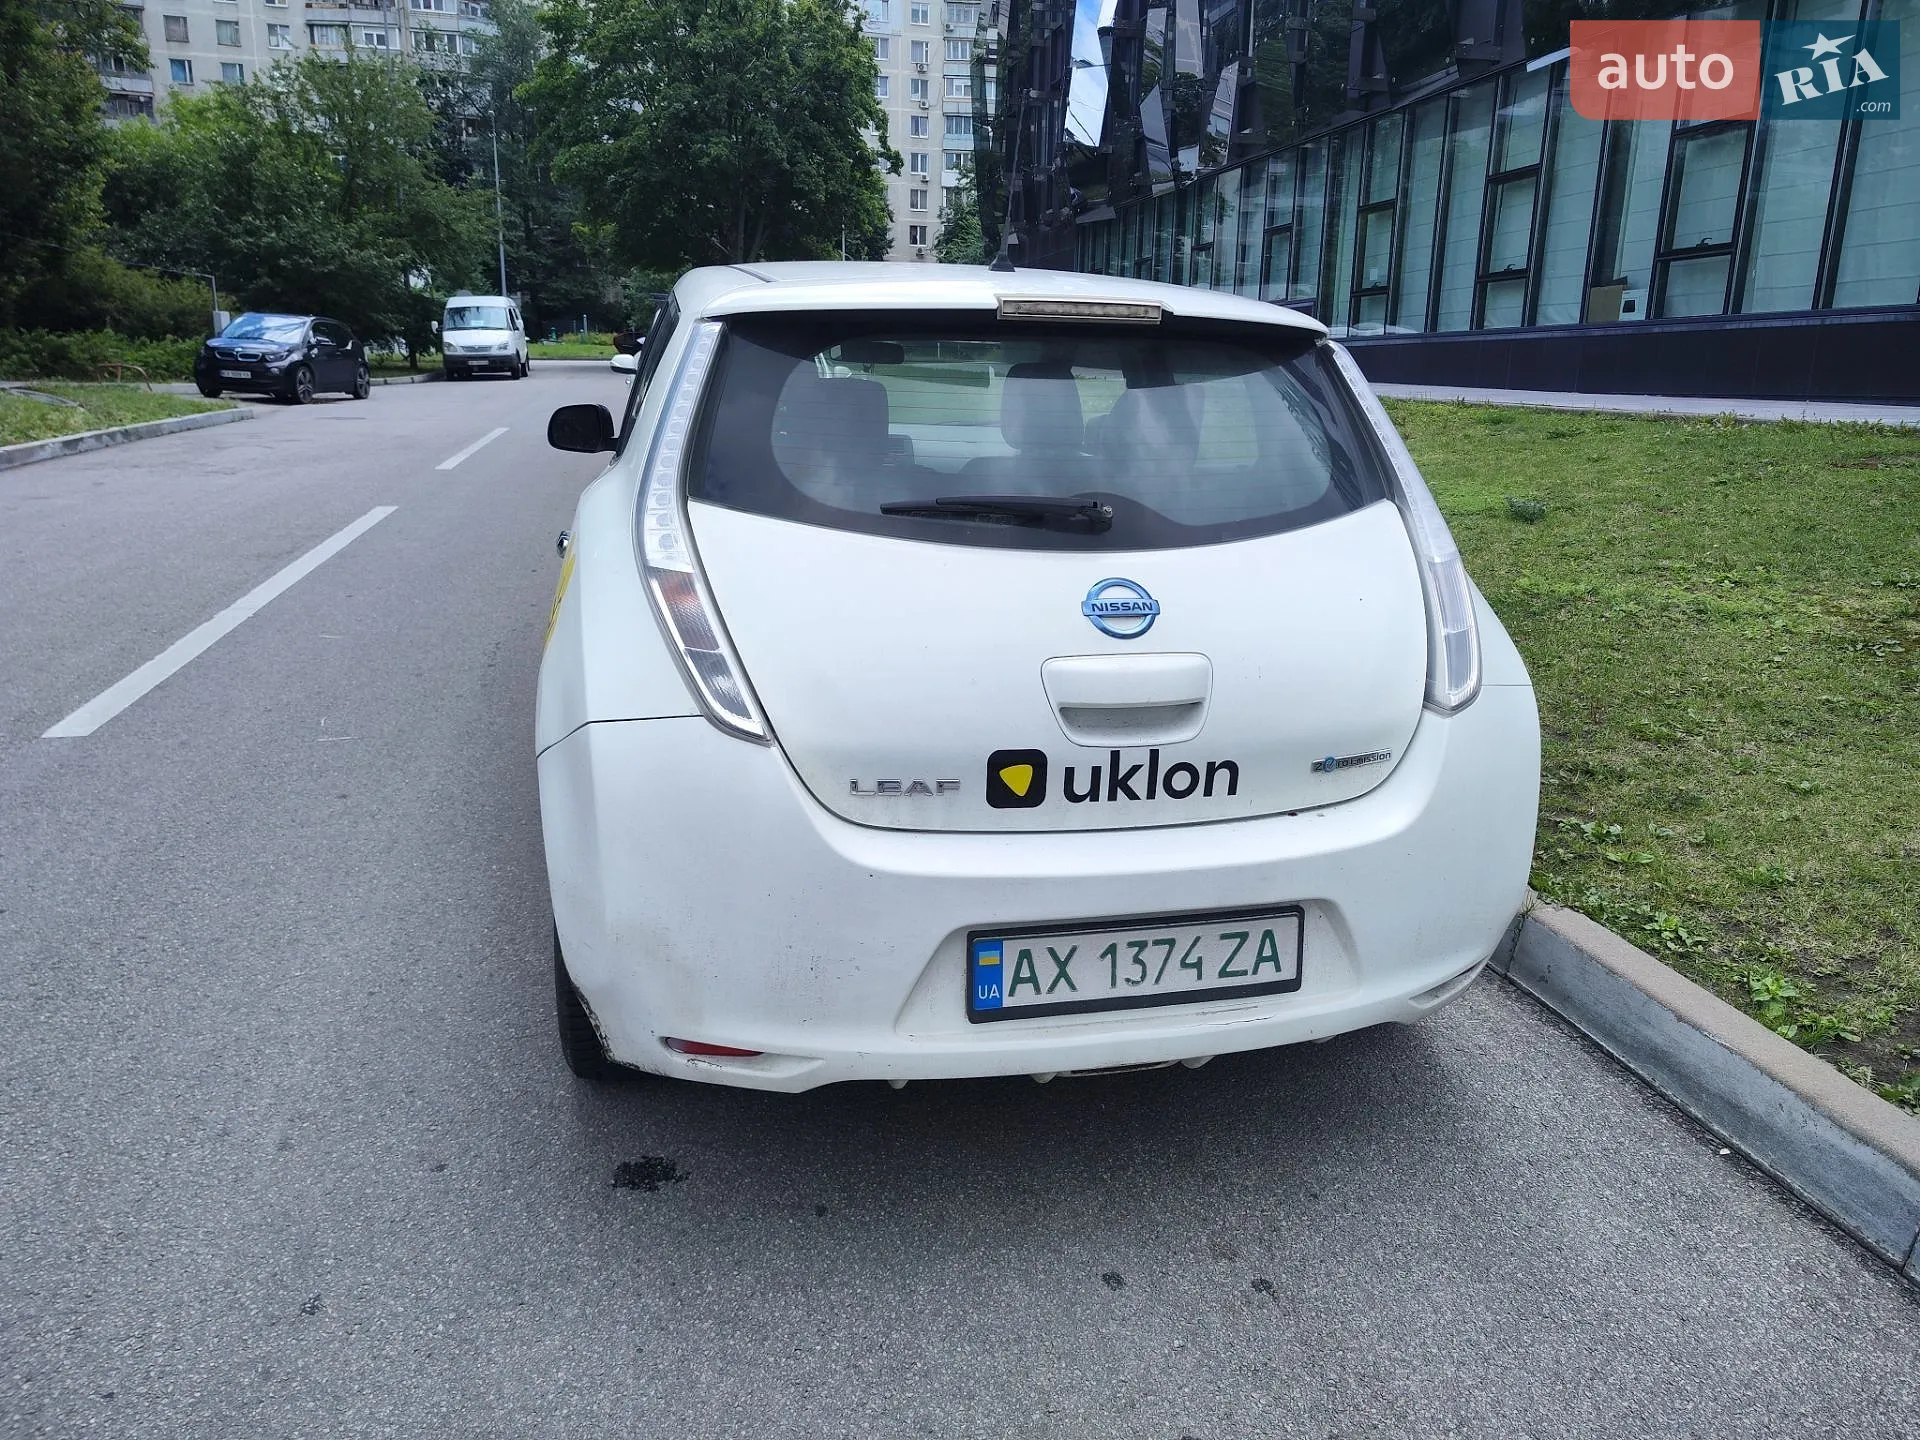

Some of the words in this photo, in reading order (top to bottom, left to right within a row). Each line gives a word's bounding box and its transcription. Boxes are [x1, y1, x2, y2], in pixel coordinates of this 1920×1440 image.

[1091, 602, 1153, 612] NISSAN
[1063, 748, 1239, 804] uklon
[849, 778, 961, 797] LEAF
[1008, 944, 1079, 998] AX
[1100, 935, 1203, 990] 1374
[1218, 928, 1283, 980] ZA
[978, 984, 1000, 1000] UA
